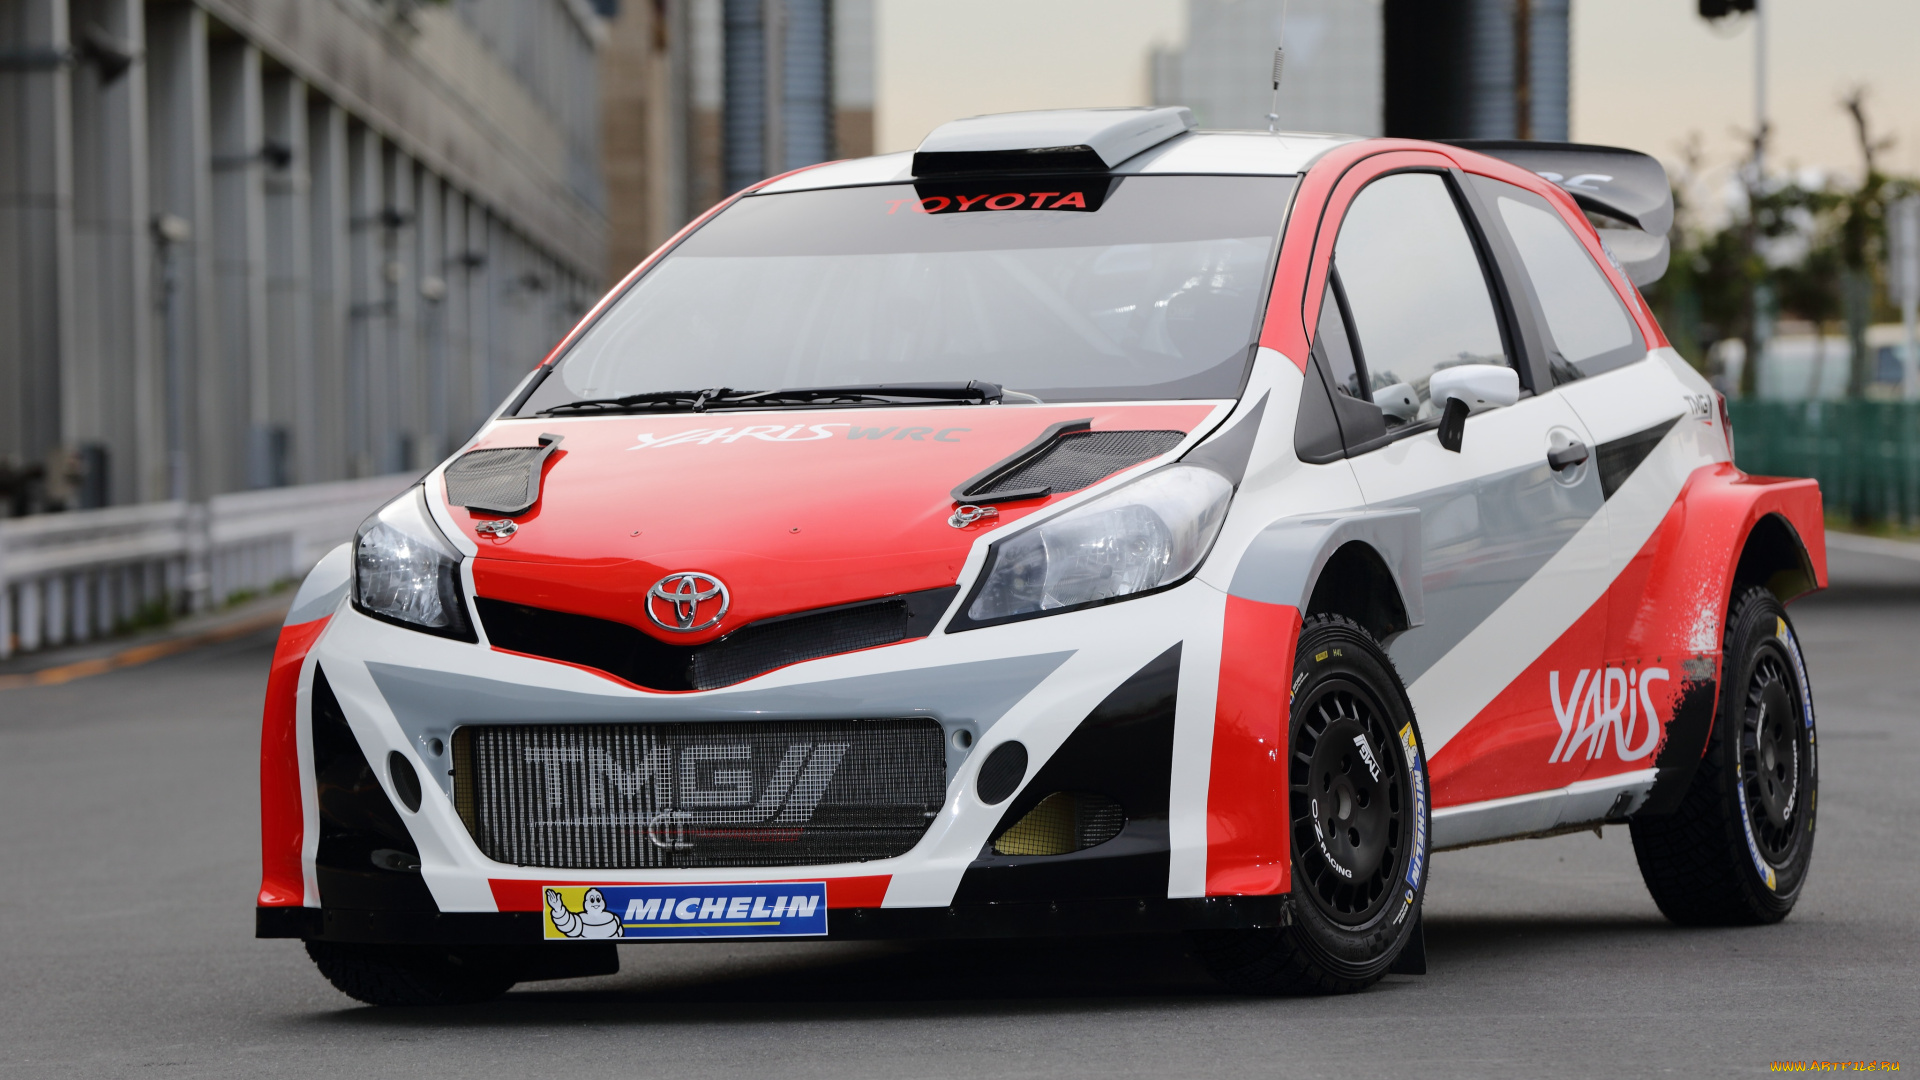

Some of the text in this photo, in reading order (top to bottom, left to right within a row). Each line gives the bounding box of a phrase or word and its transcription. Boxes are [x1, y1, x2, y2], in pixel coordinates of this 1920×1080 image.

[885, 191, 1087, 215] TOYOTA
[847, 426, 972, 442] WRC
[1411, 769, 1426, 887] MICHELIN
[1320, 842, 1352, 879] RACING
[624, 895, 820, 921] MICHELIN
